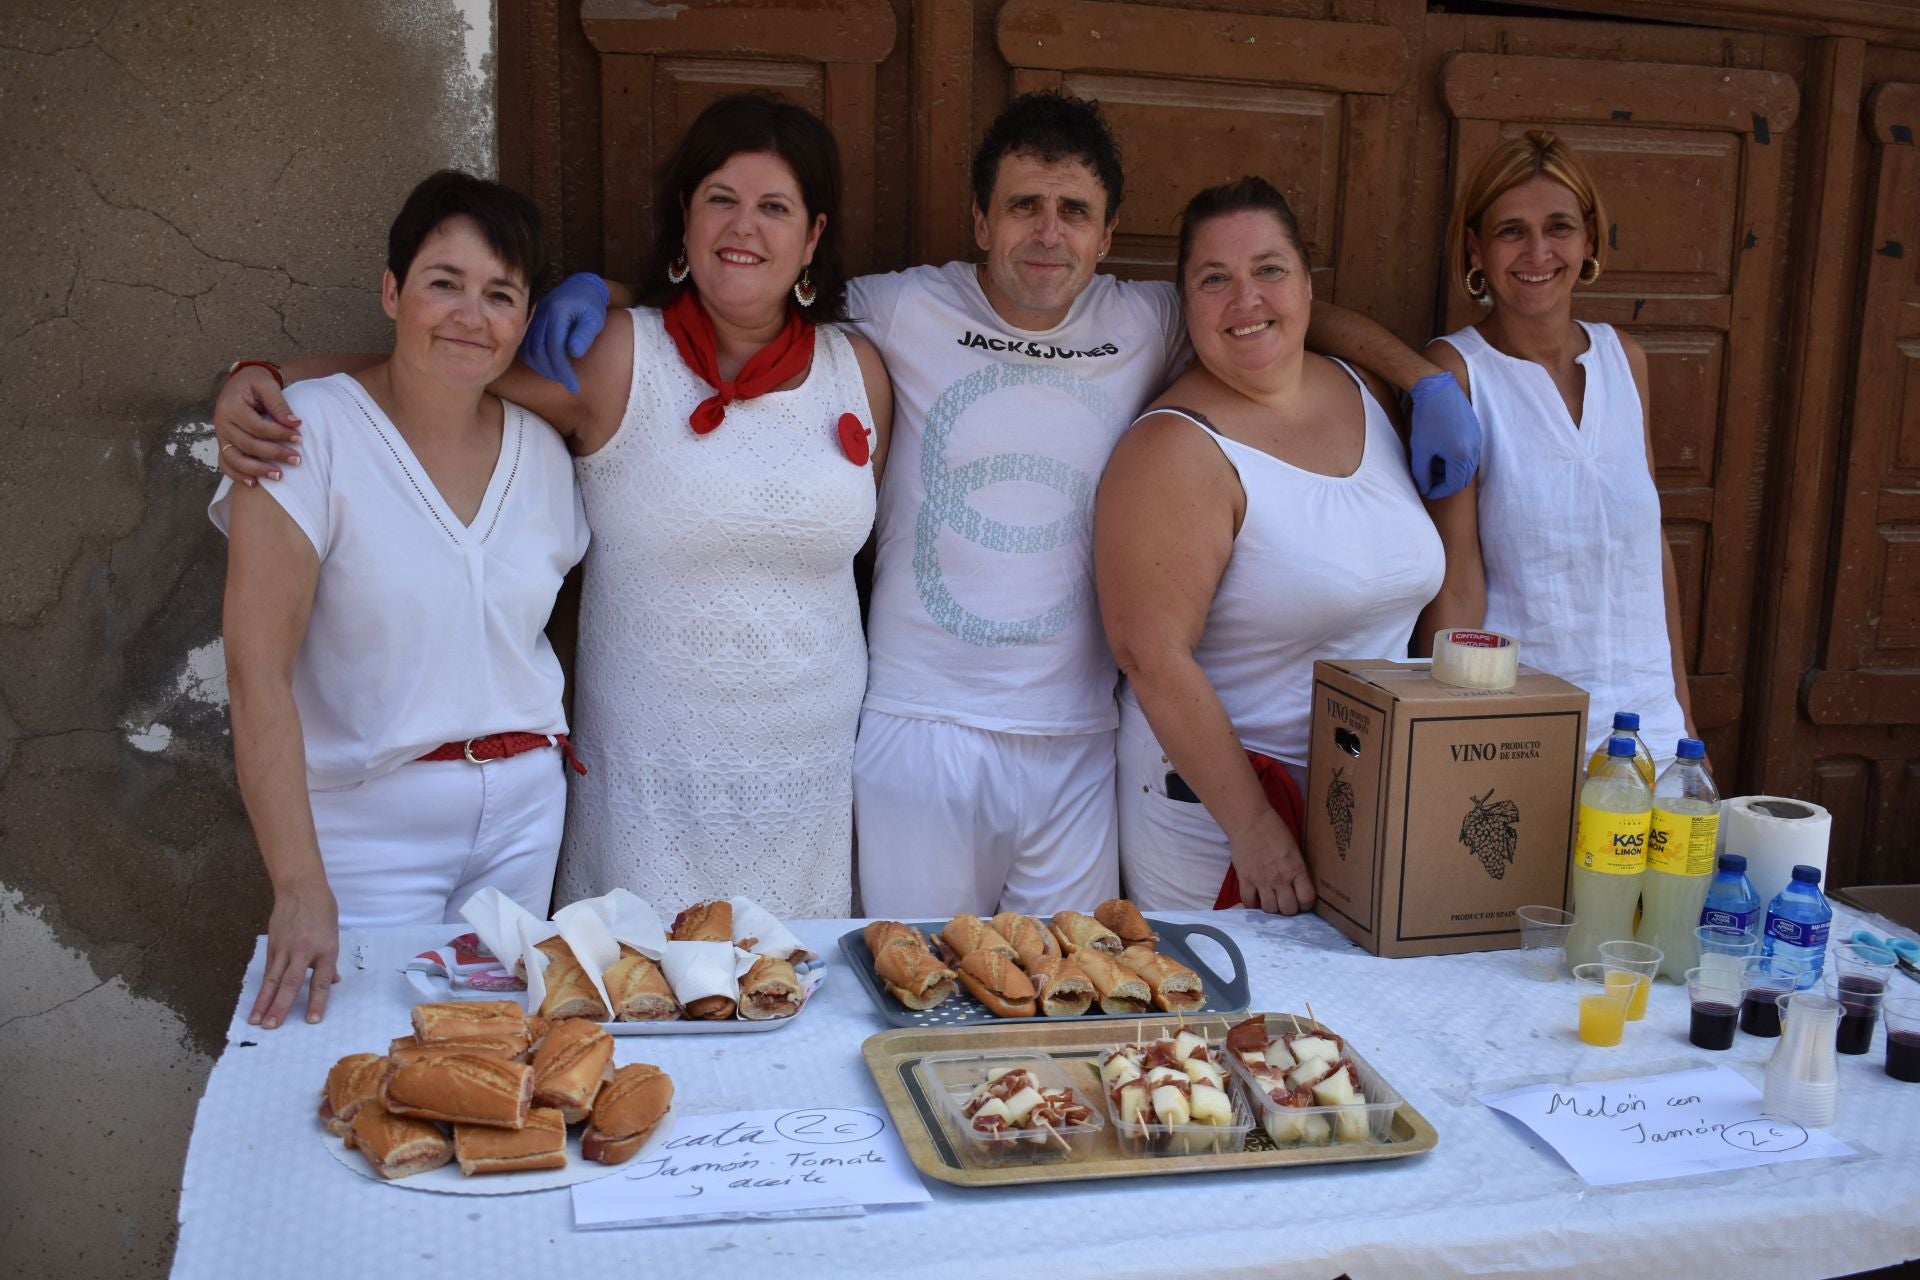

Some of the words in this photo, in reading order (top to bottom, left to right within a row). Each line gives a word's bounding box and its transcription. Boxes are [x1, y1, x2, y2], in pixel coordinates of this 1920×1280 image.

[1327, 697, 1349, 723] VINO
[1450, 742, 1497, 762] VINO
[1500, 741, 1540, 751] PRODUCTO
[1500, 752, 1510, 760] DE
[1511, 749, 1540, 760] ESPAÑA
[1613, 833, 1644, 847] KAS
[1649, 828, 1669, 845] AS
[1451, 912, 1484, 921] PRODUCT
[1485, 911, 1495, 919] OF
[1666, 1096, 1701, 1107] con
[662, 1122, 779, 1149] cata
[786, 1150, 885, 1166] Tomate
[672, 1185, 704, 1198] y
[728, 1170, 826, 1189] aceite
